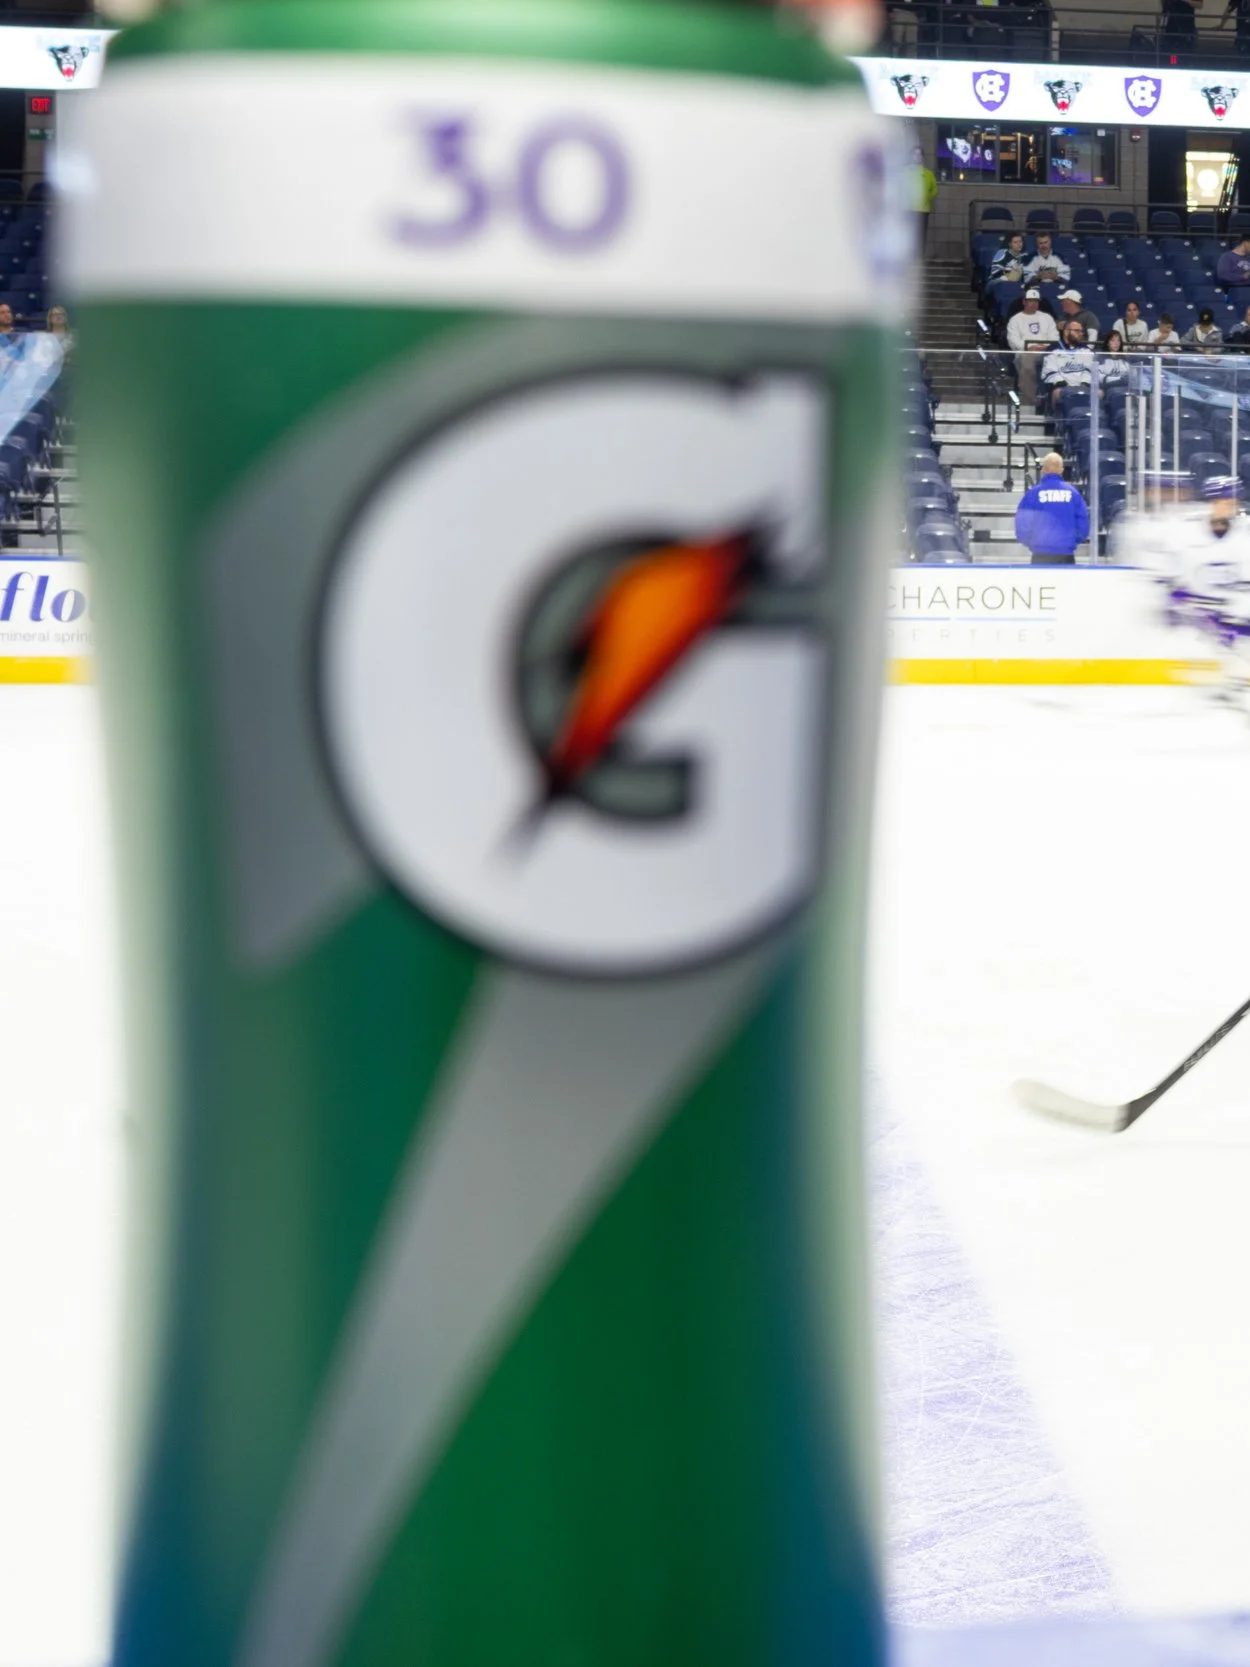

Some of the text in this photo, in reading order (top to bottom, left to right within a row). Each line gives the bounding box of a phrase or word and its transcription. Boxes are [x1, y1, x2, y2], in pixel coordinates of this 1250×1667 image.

[390, 106, 634, 256] 30
[1038, 489, 1073, 503] STAFF
[0, 571, 97, 623] flo
[320, 368, 832, 972] G
